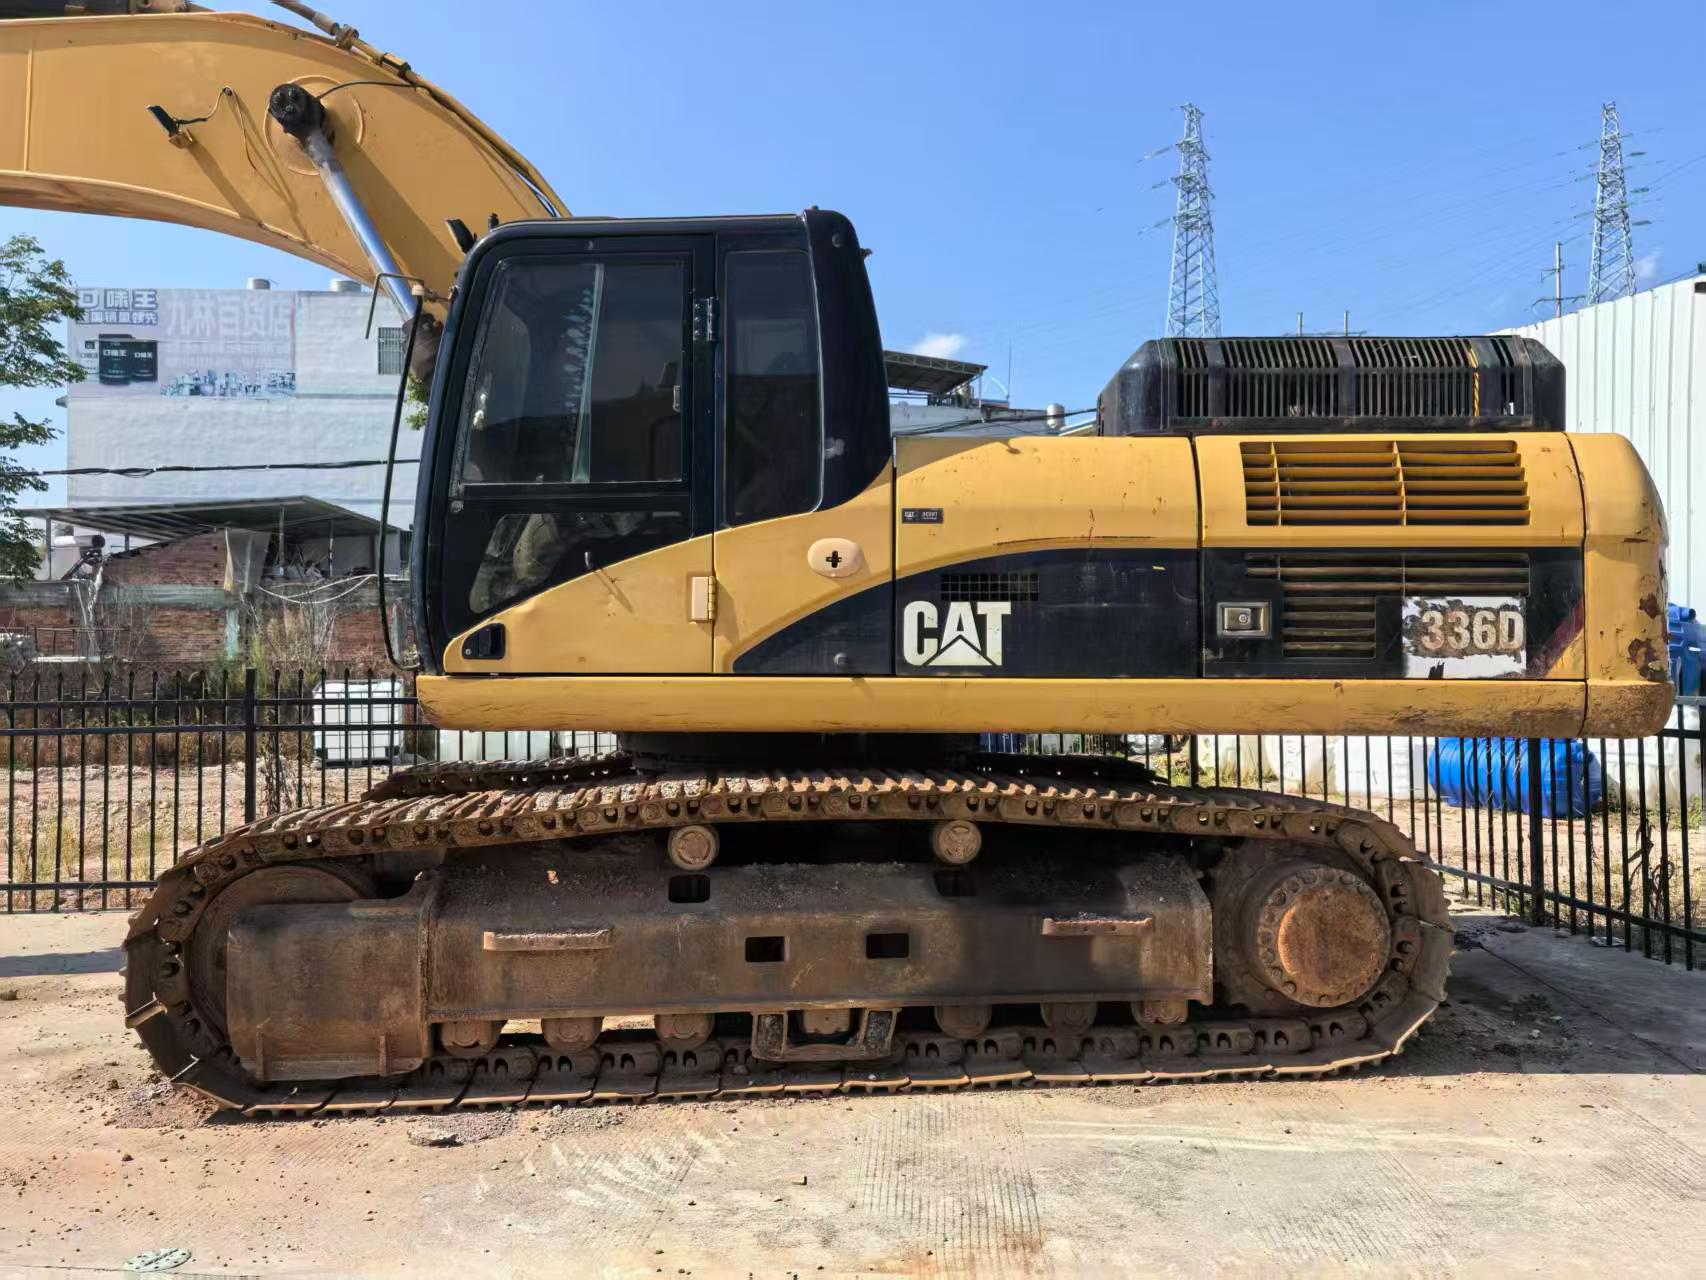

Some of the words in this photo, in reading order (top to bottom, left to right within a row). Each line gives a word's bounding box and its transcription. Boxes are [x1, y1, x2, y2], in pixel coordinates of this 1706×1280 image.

[77, 289, 158, 309] 口味王
[903, 601, 1011, 666] CAT
[1420, 610, 1524, 650] 336D
